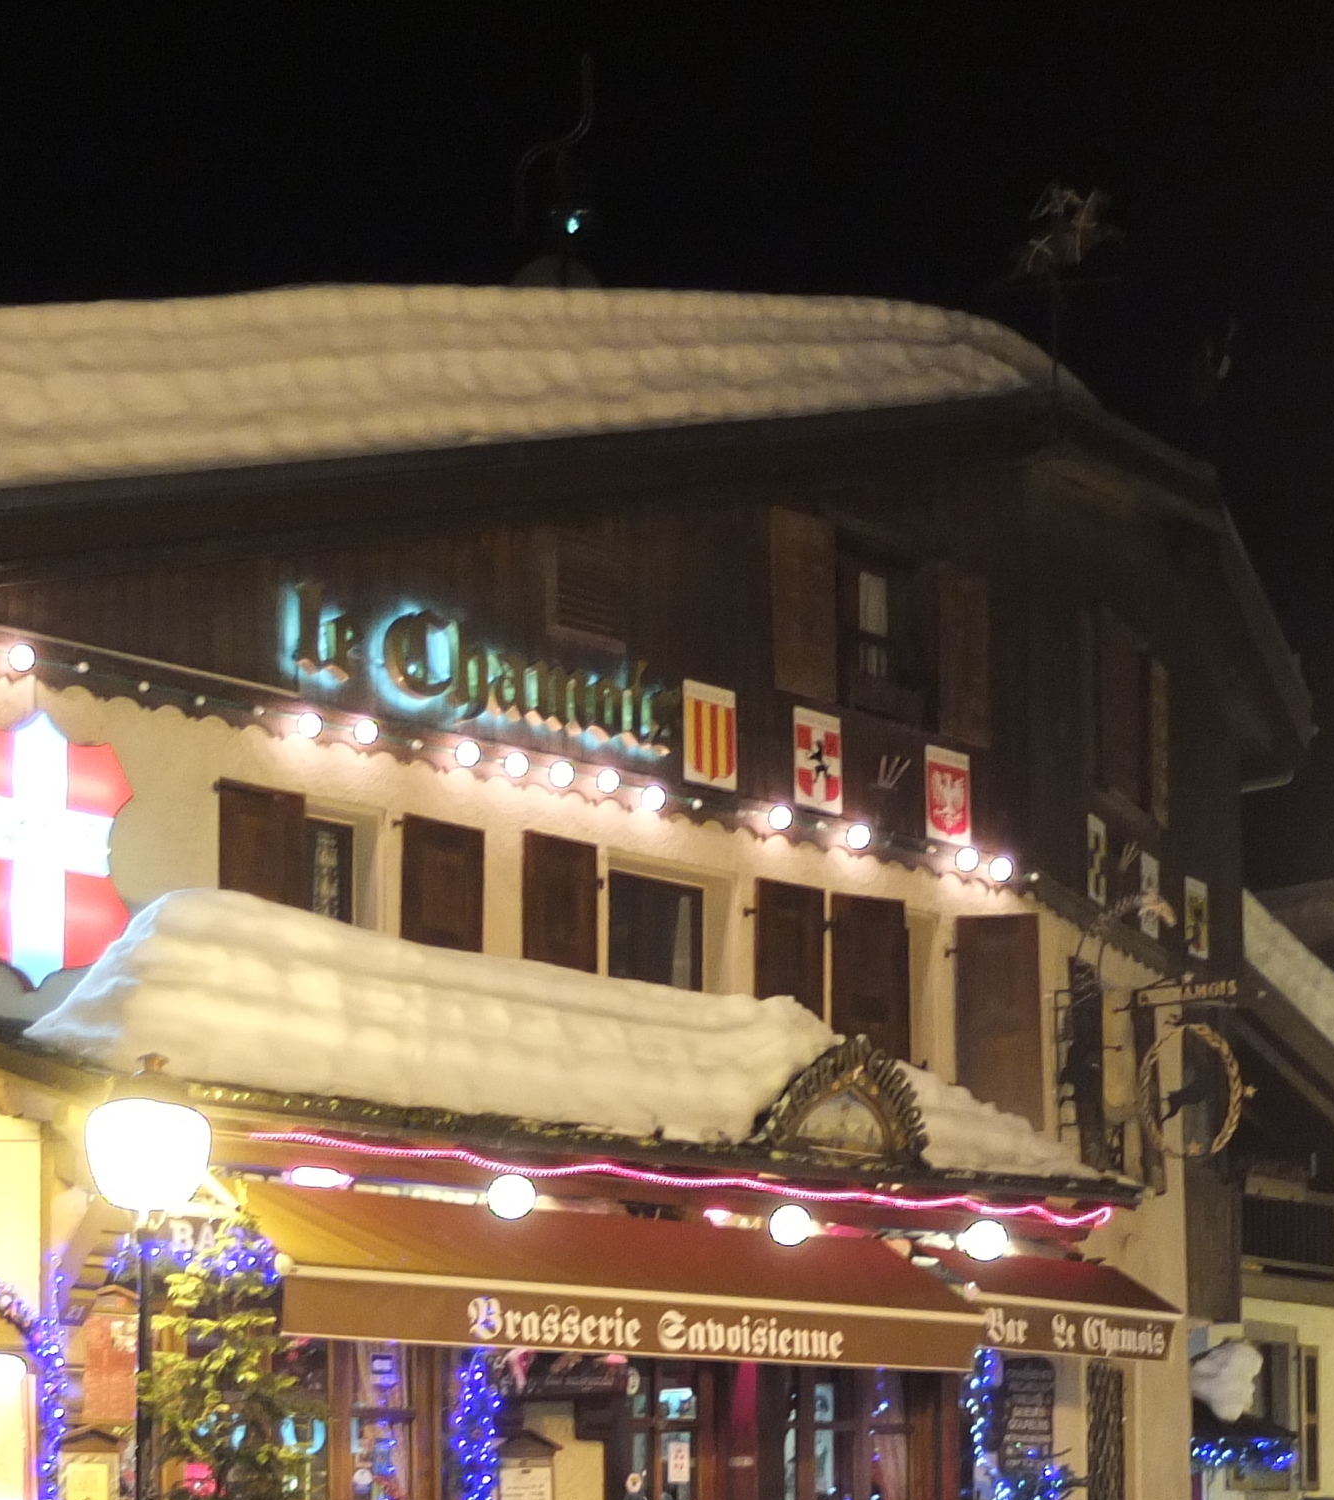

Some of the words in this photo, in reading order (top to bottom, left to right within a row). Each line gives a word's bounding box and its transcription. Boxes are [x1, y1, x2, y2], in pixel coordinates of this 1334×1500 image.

[467, 1296, 643, 1348] Brasserie
[657, 1308, 845, 1359] Savoisienne
[982, 1306, 1029, 1345] Bar
[1082, 1315, 1167, 1357] Chamois
